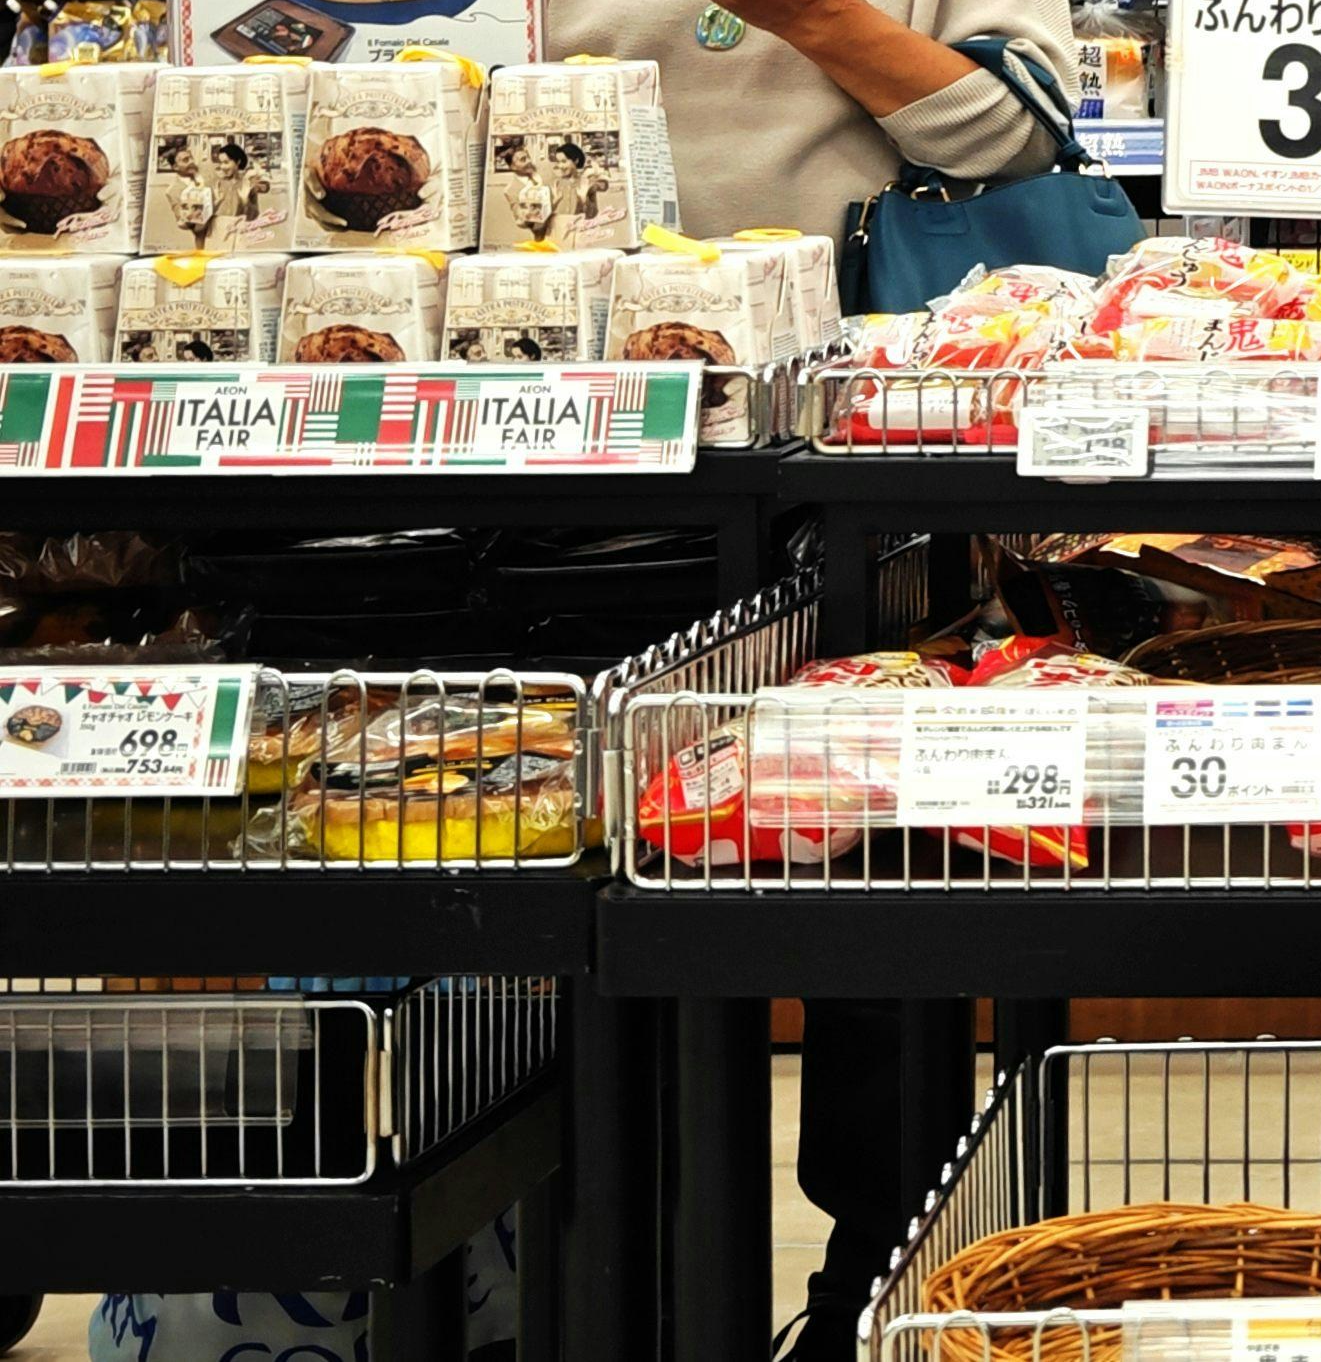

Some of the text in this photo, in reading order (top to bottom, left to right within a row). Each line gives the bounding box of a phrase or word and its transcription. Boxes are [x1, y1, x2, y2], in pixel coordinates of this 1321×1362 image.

[176, 396, 277, 427] ITALIA
[481, 396, 582, 426] ITALIA
[197, 428, 251, 450] FAIR
[502, 427, 557, 450] FAIR
[81, 711, 133, 722] チャオチャオ
[1169, 755, 1228, 799] 30
